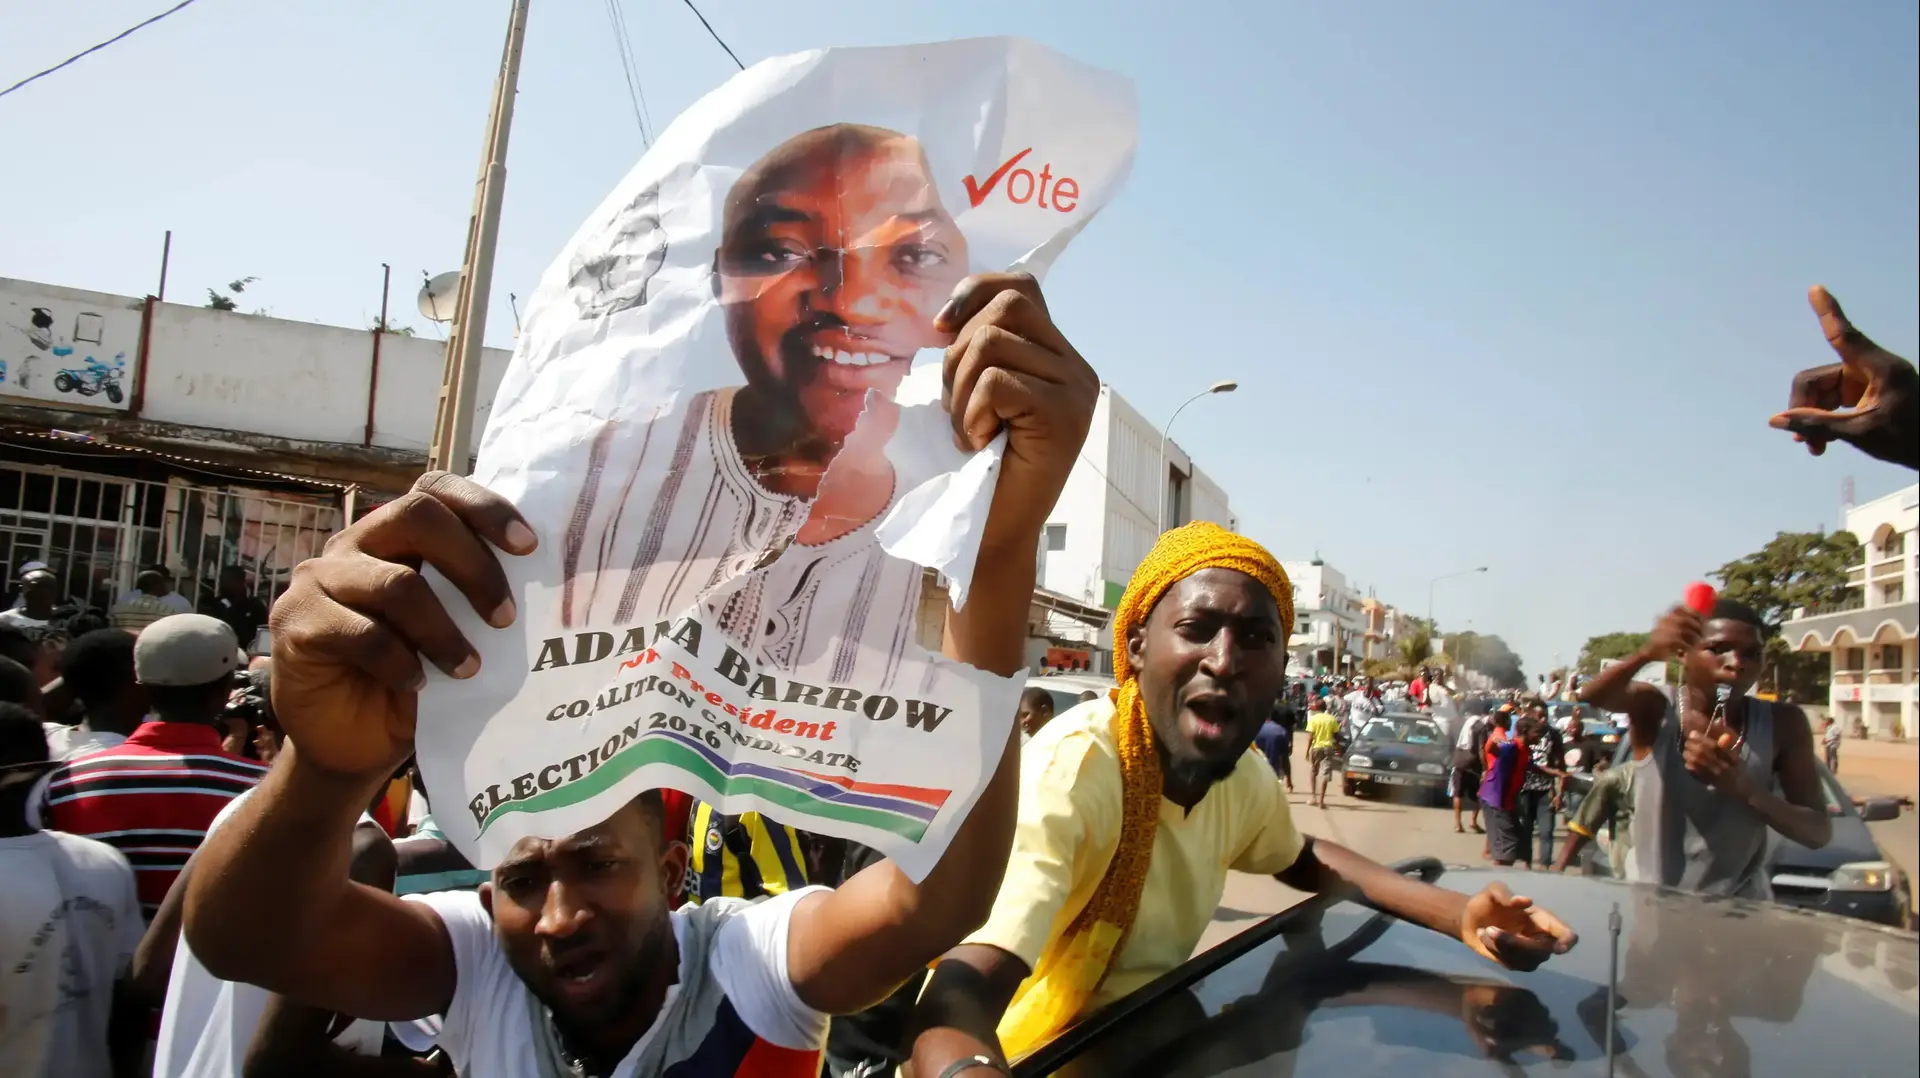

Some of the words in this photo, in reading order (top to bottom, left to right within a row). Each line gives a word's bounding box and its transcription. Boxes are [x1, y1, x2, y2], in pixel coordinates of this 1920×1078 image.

[546, 675, 696, 722] COALITION
[671, 661, 837, 740] President
[713, 644, 953, 733] BARROW
[468, 717, 642, 829] ELECTION
[648, 712, 721, 749] 2016
